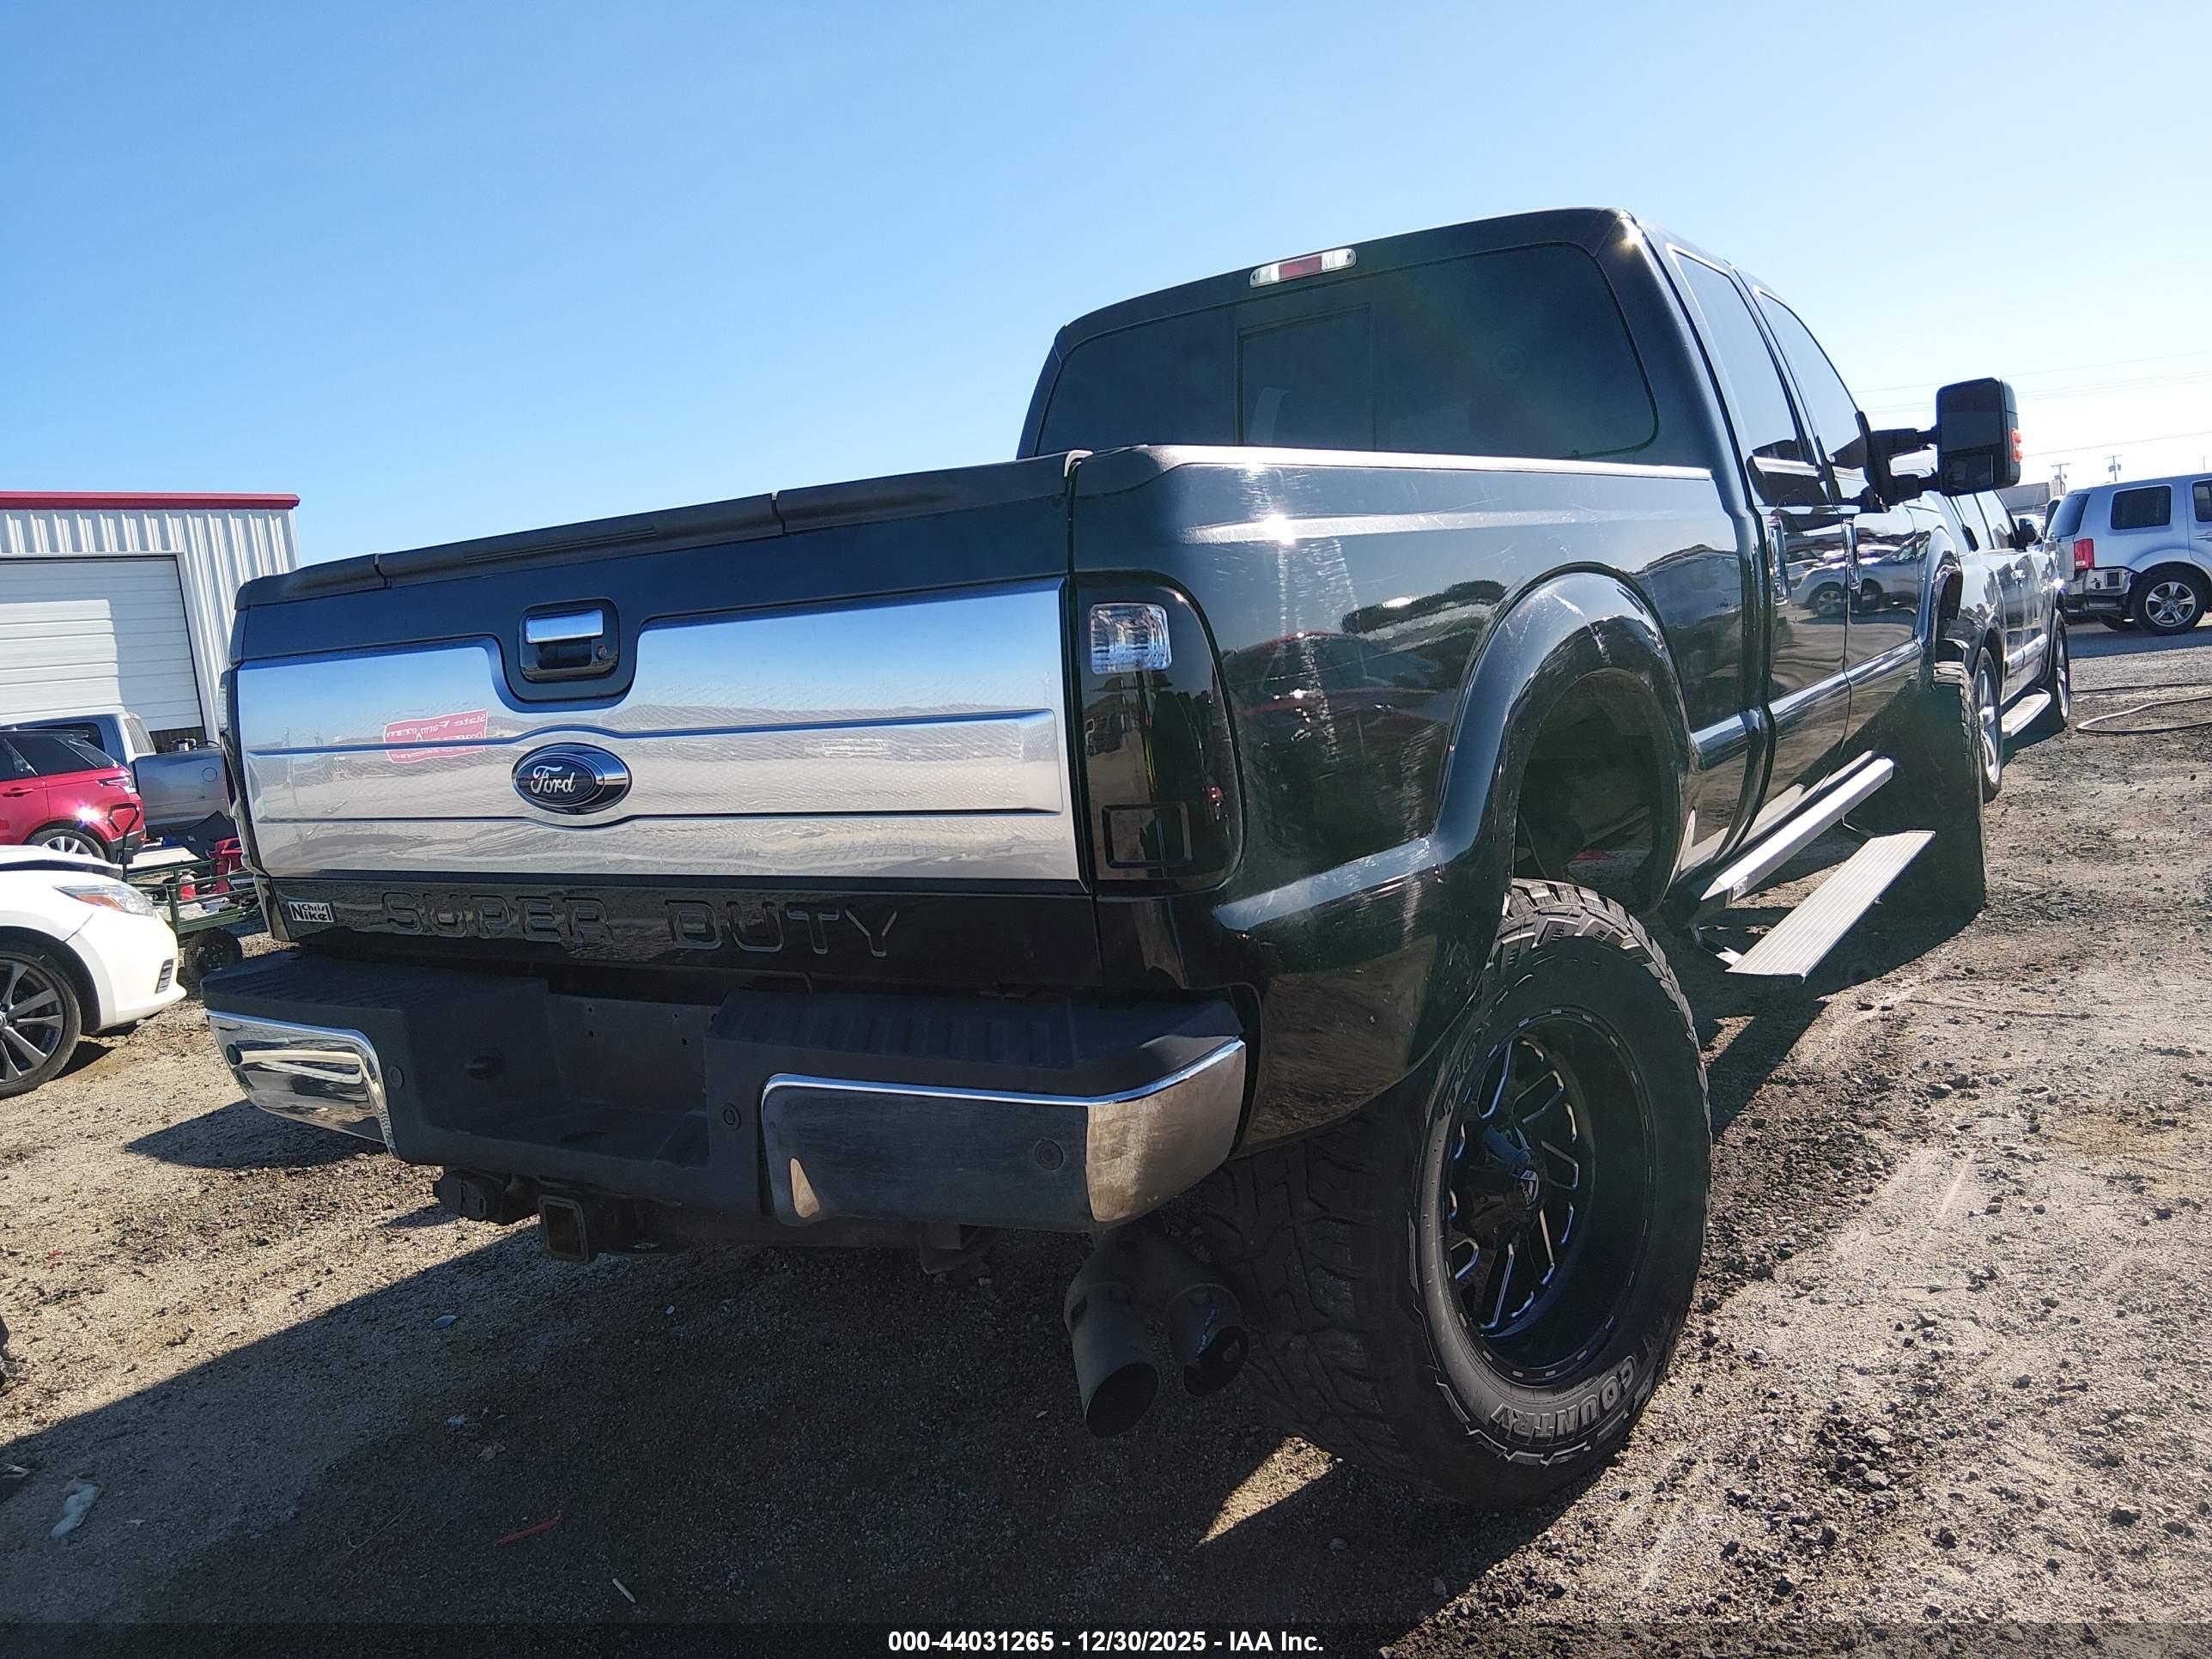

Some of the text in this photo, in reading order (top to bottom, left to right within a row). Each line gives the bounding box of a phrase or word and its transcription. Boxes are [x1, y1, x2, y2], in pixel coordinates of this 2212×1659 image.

[530, 764, 576, 793] Ford
[290, 903, 332, 921] Nikel
[380, 891, 898, 957] SUPER DUTY
[1491, 1355, 1637, 1437] COUNTRY
